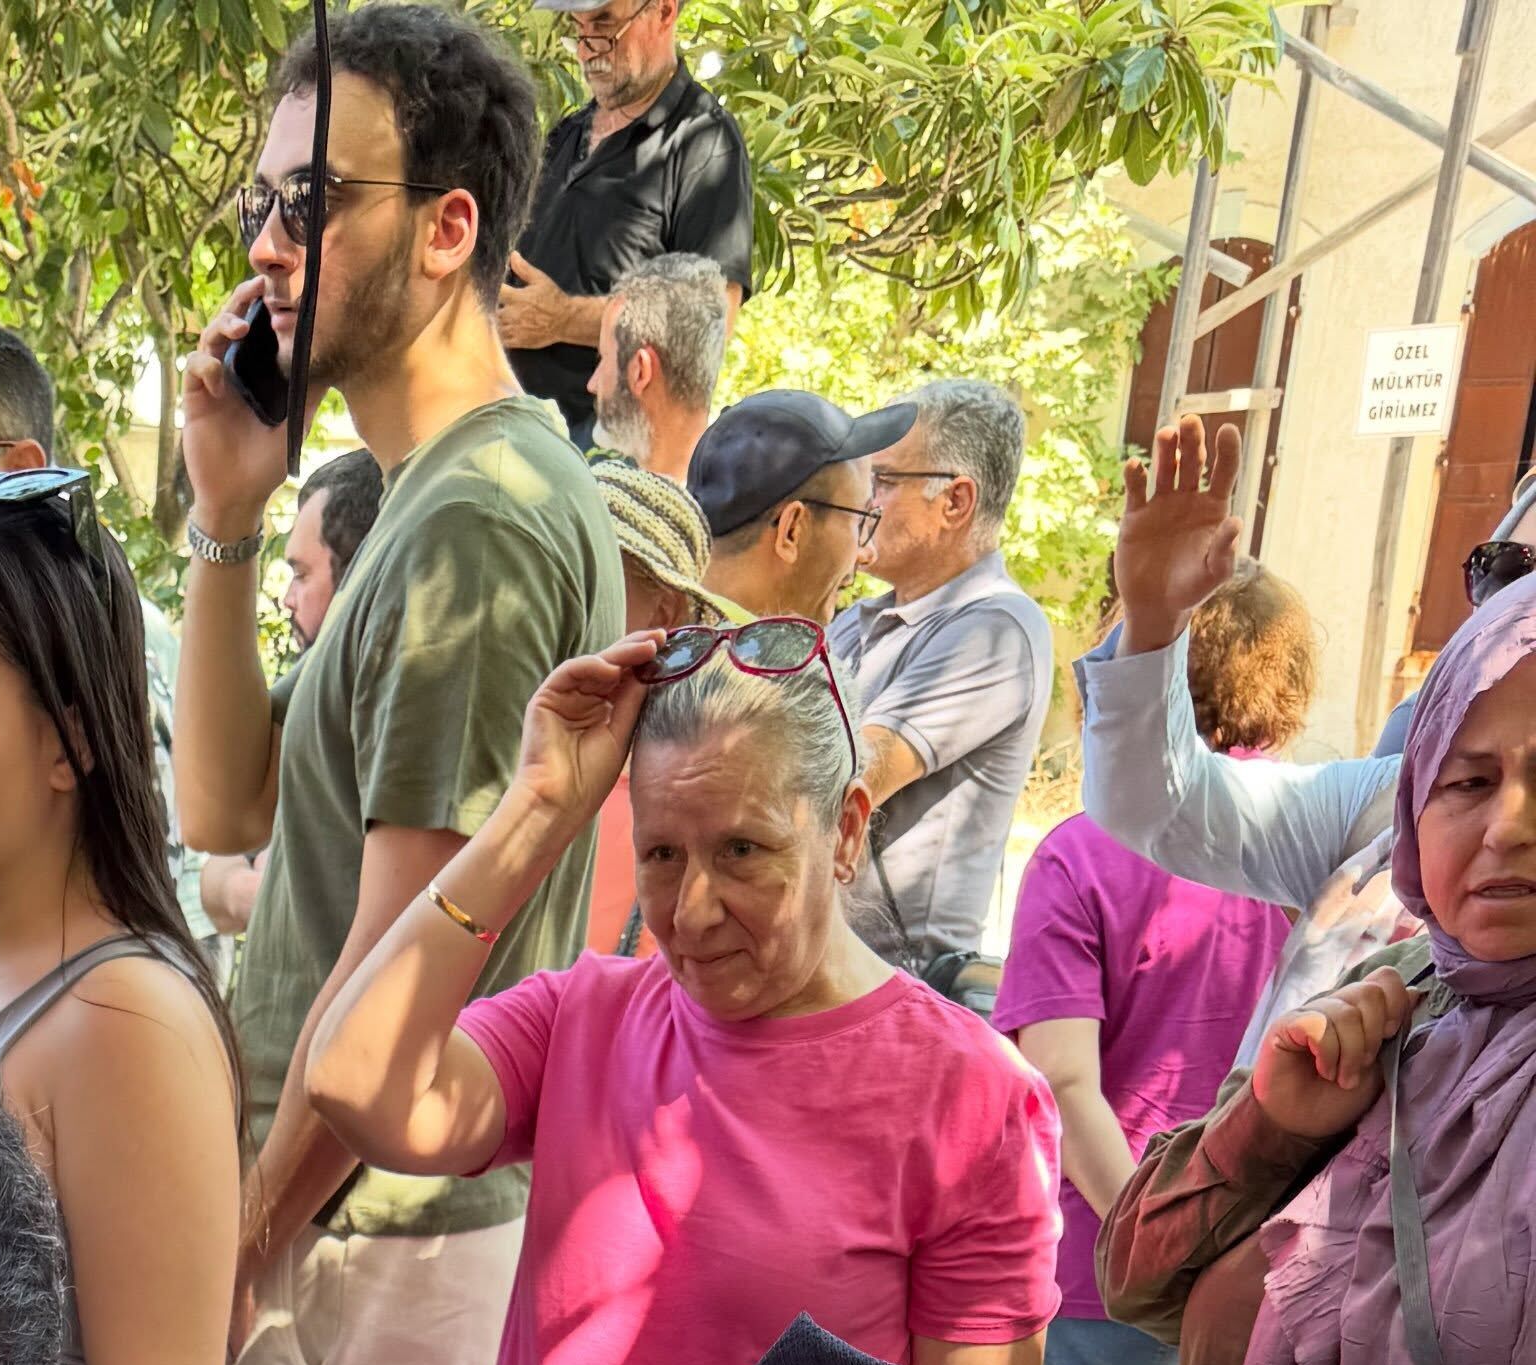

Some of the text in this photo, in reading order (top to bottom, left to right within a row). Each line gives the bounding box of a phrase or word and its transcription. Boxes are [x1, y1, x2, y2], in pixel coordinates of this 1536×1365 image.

[1394, 341, 1430, 362] ÖZEL
[1371, 369, 1443, 391] MÜLKTÜR
[1368, 400, 1437, 421] GİRİLMEZ
